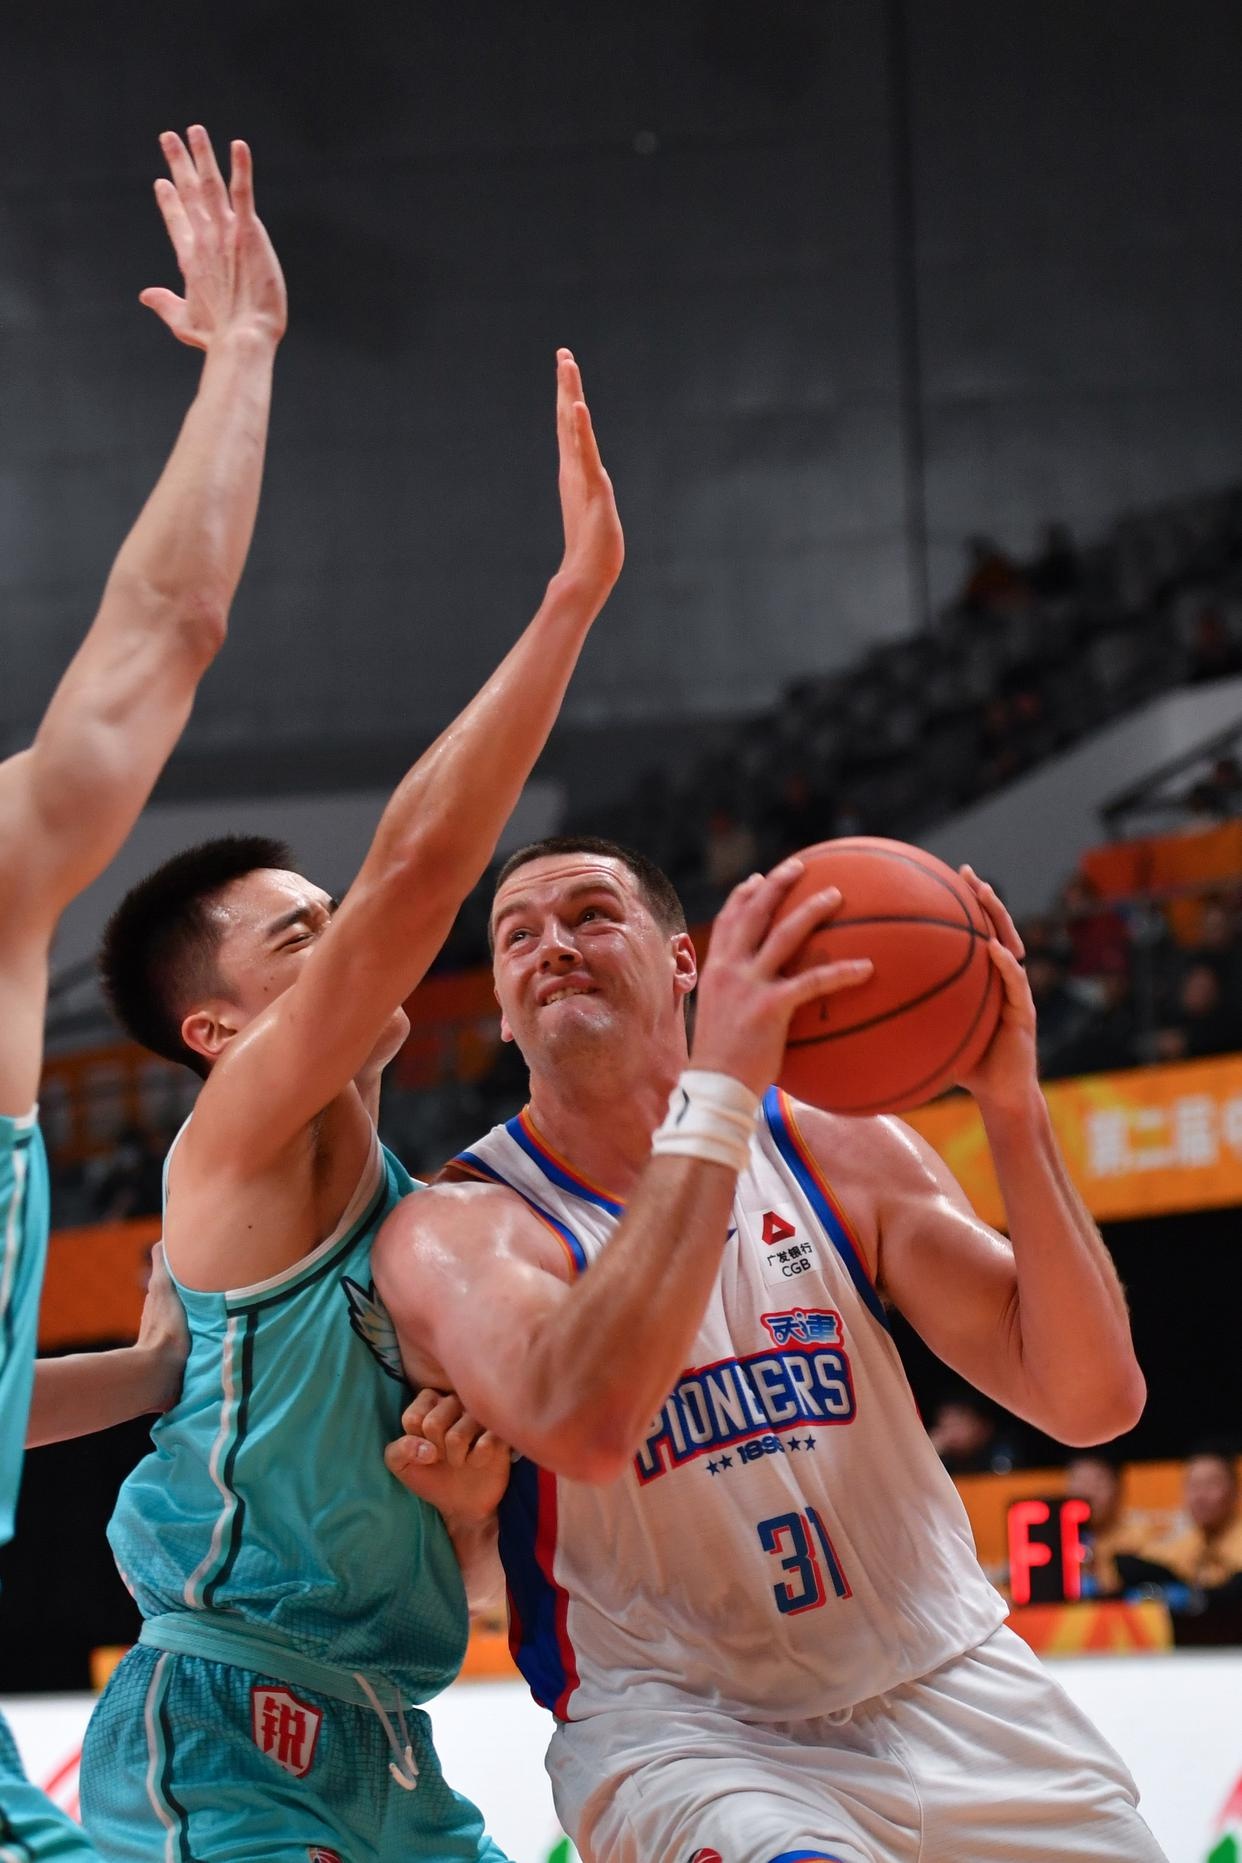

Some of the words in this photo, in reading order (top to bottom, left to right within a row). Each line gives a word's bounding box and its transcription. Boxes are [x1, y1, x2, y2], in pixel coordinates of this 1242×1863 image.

[767, 1242, 812, 1267] 广发银行
[782, 1258, 811, 1277] CGB
[766, 1312, 840, 1344] 天津
[757, 1506, 852, 1616] 31
